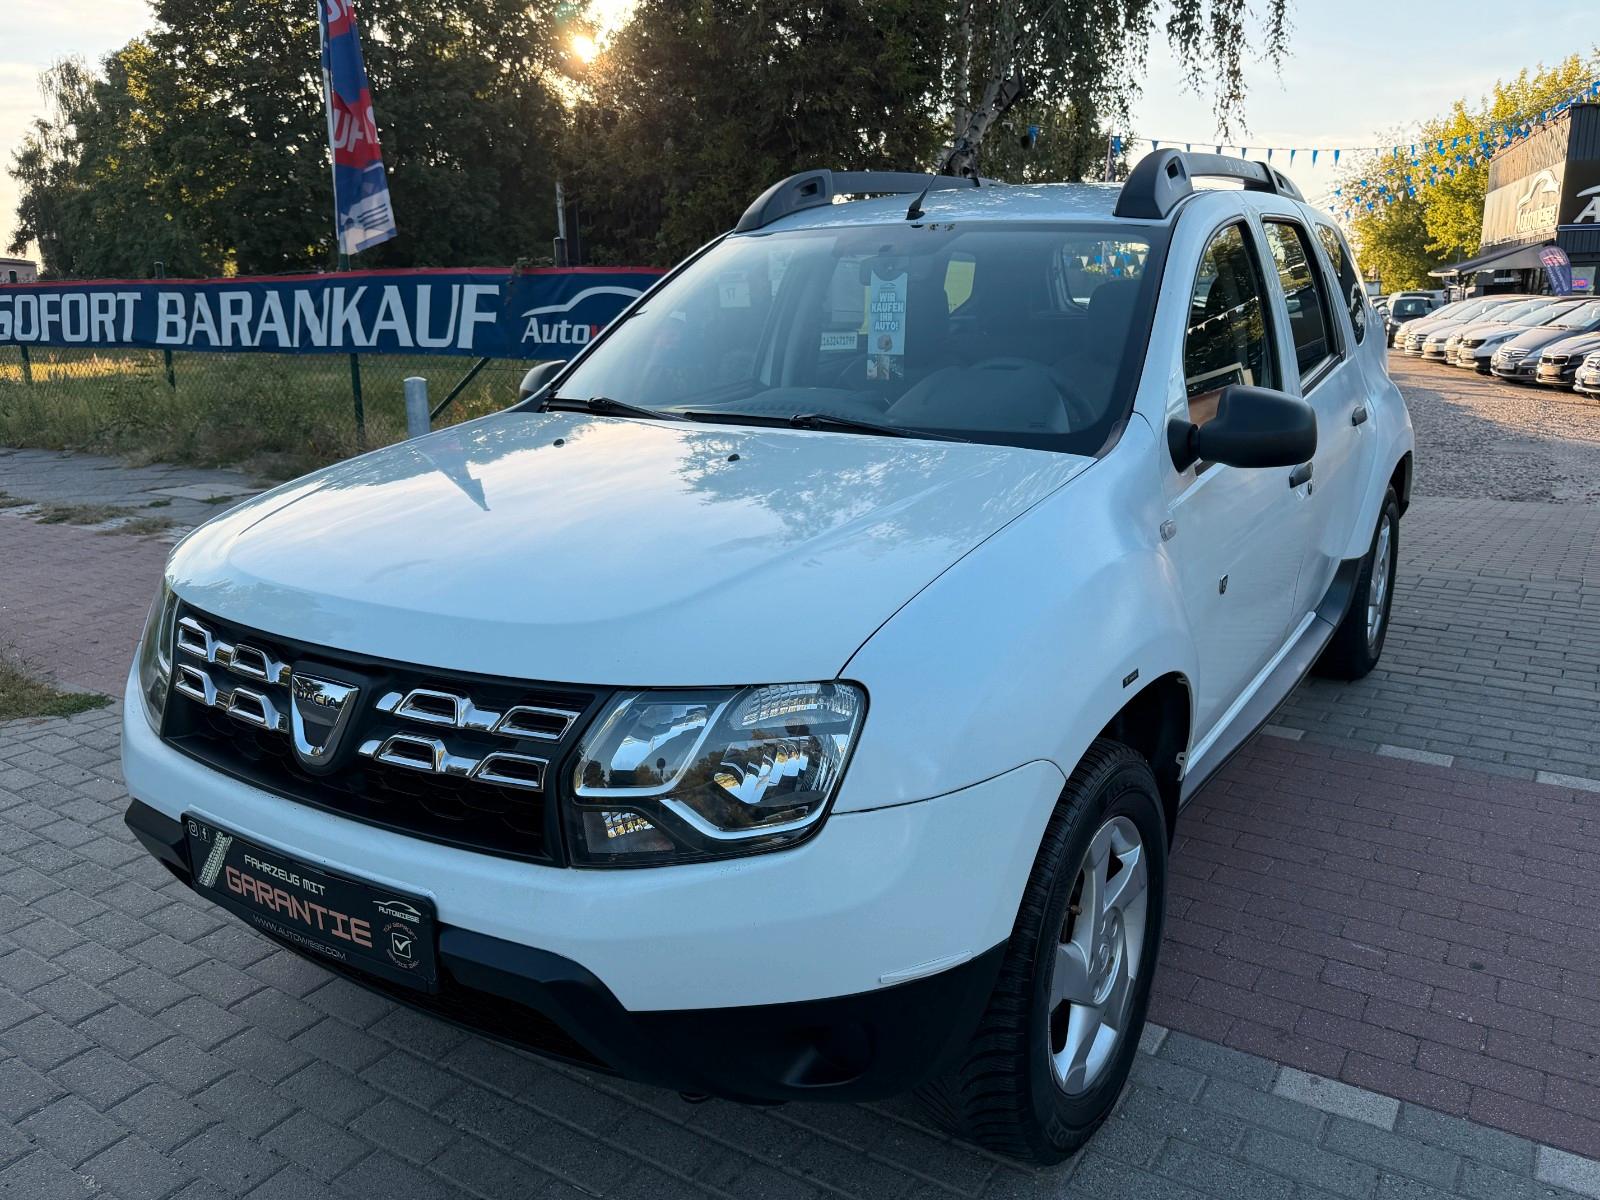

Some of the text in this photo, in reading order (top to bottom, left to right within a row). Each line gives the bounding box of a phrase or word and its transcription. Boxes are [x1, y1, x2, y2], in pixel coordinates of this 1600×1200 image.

[880, 292, 896, 302] WIR
[0, 284, 500, 349] SOFORT BARANKAUF
[871, 302, 904, 313] KAUFEN
[880, 312, 892, 322] IHR
[874, 321, 898, 331] AUTO!
[297, 688, 338, 708] DACIA
[244, 854, 326, 897] FAHRZEUG MIT
[225, 865, 373, 949] GARANTIE
[252, 913, 347, 961] WWW.AUTOWIESE.COM
